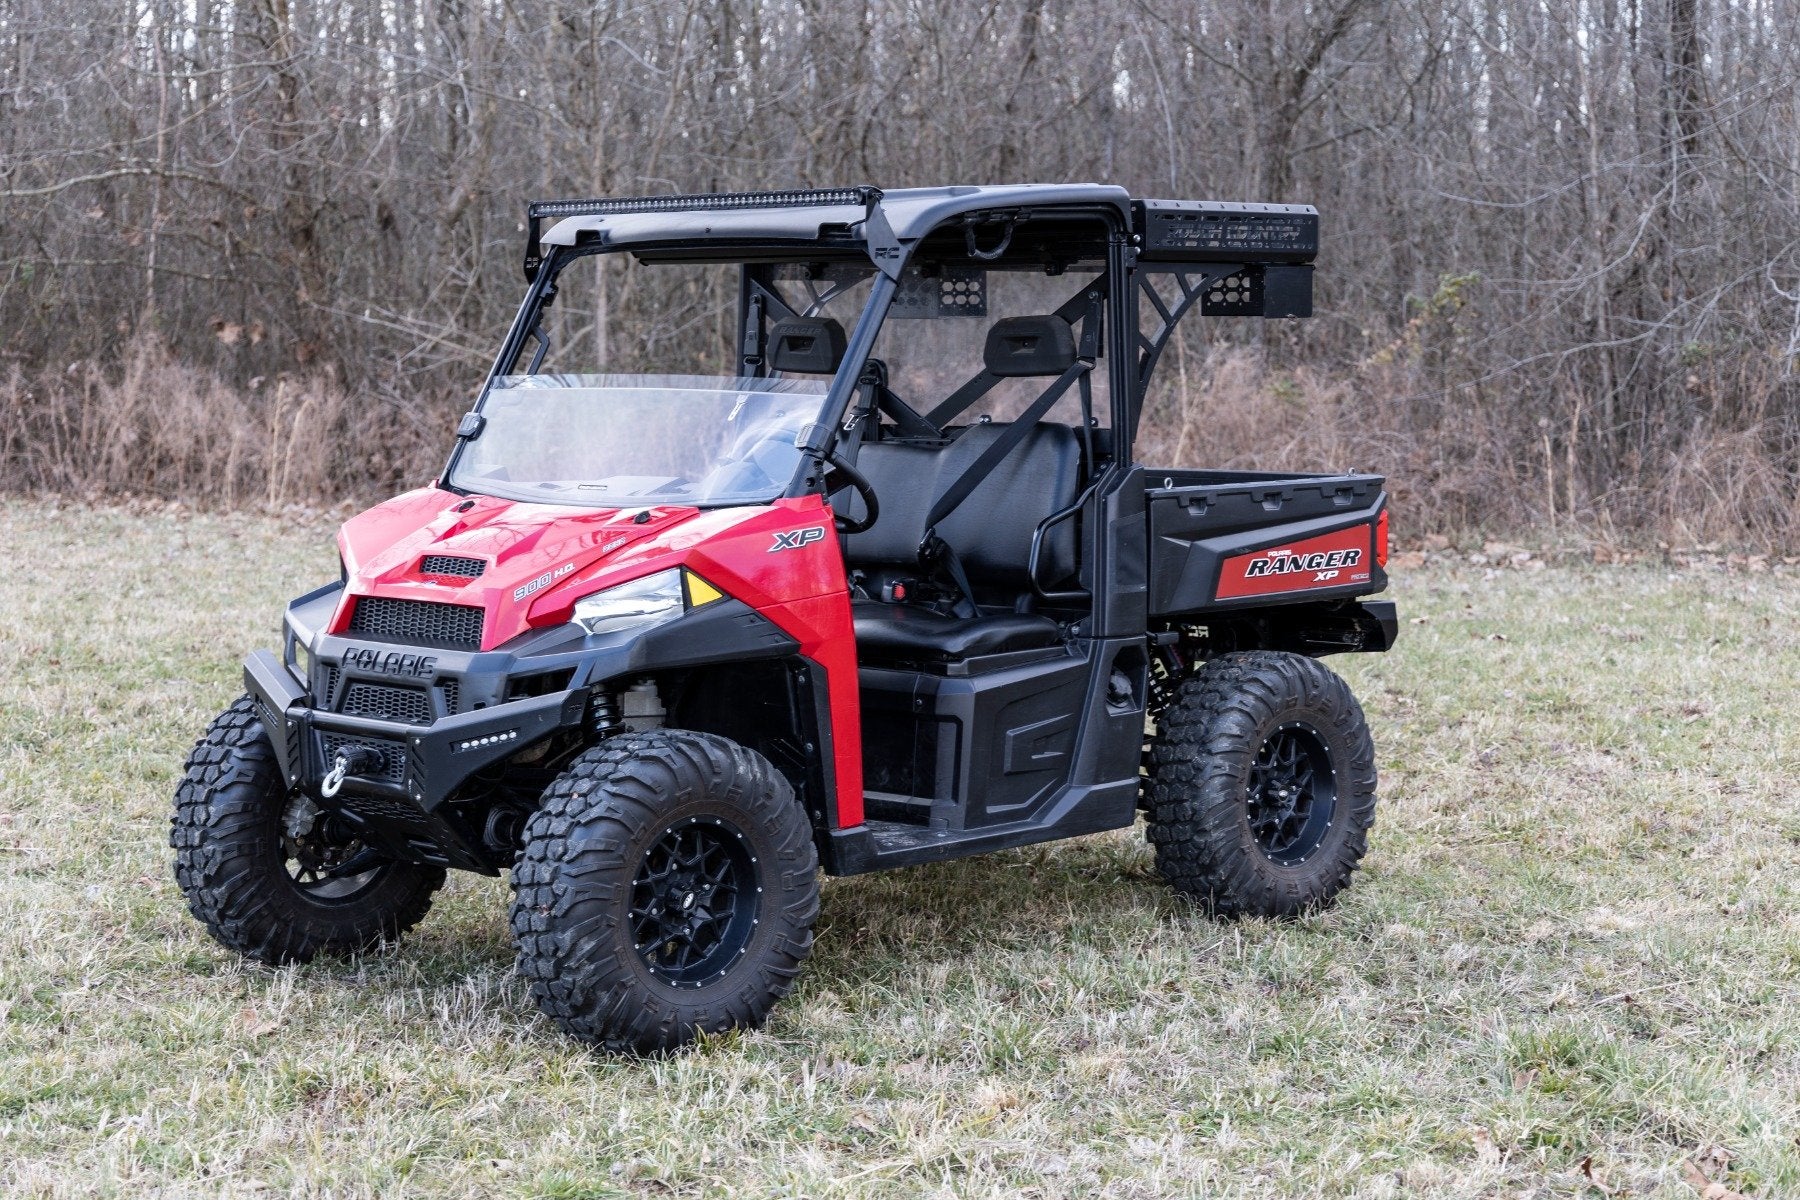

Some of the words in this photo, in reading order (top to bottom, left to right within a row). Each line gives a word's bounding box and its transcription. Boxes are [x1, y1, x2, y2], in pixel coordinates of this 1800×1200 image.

[767, 526, 825, 552] XP
[1267, 549, 1292, 557] POLARIS
[1244, 548, 1361, 578] RANGER
[1313, 570, 1339, 582] XP
[514, 572, 552, 602] 900
[342, 647, 438, 679] POLARIS
